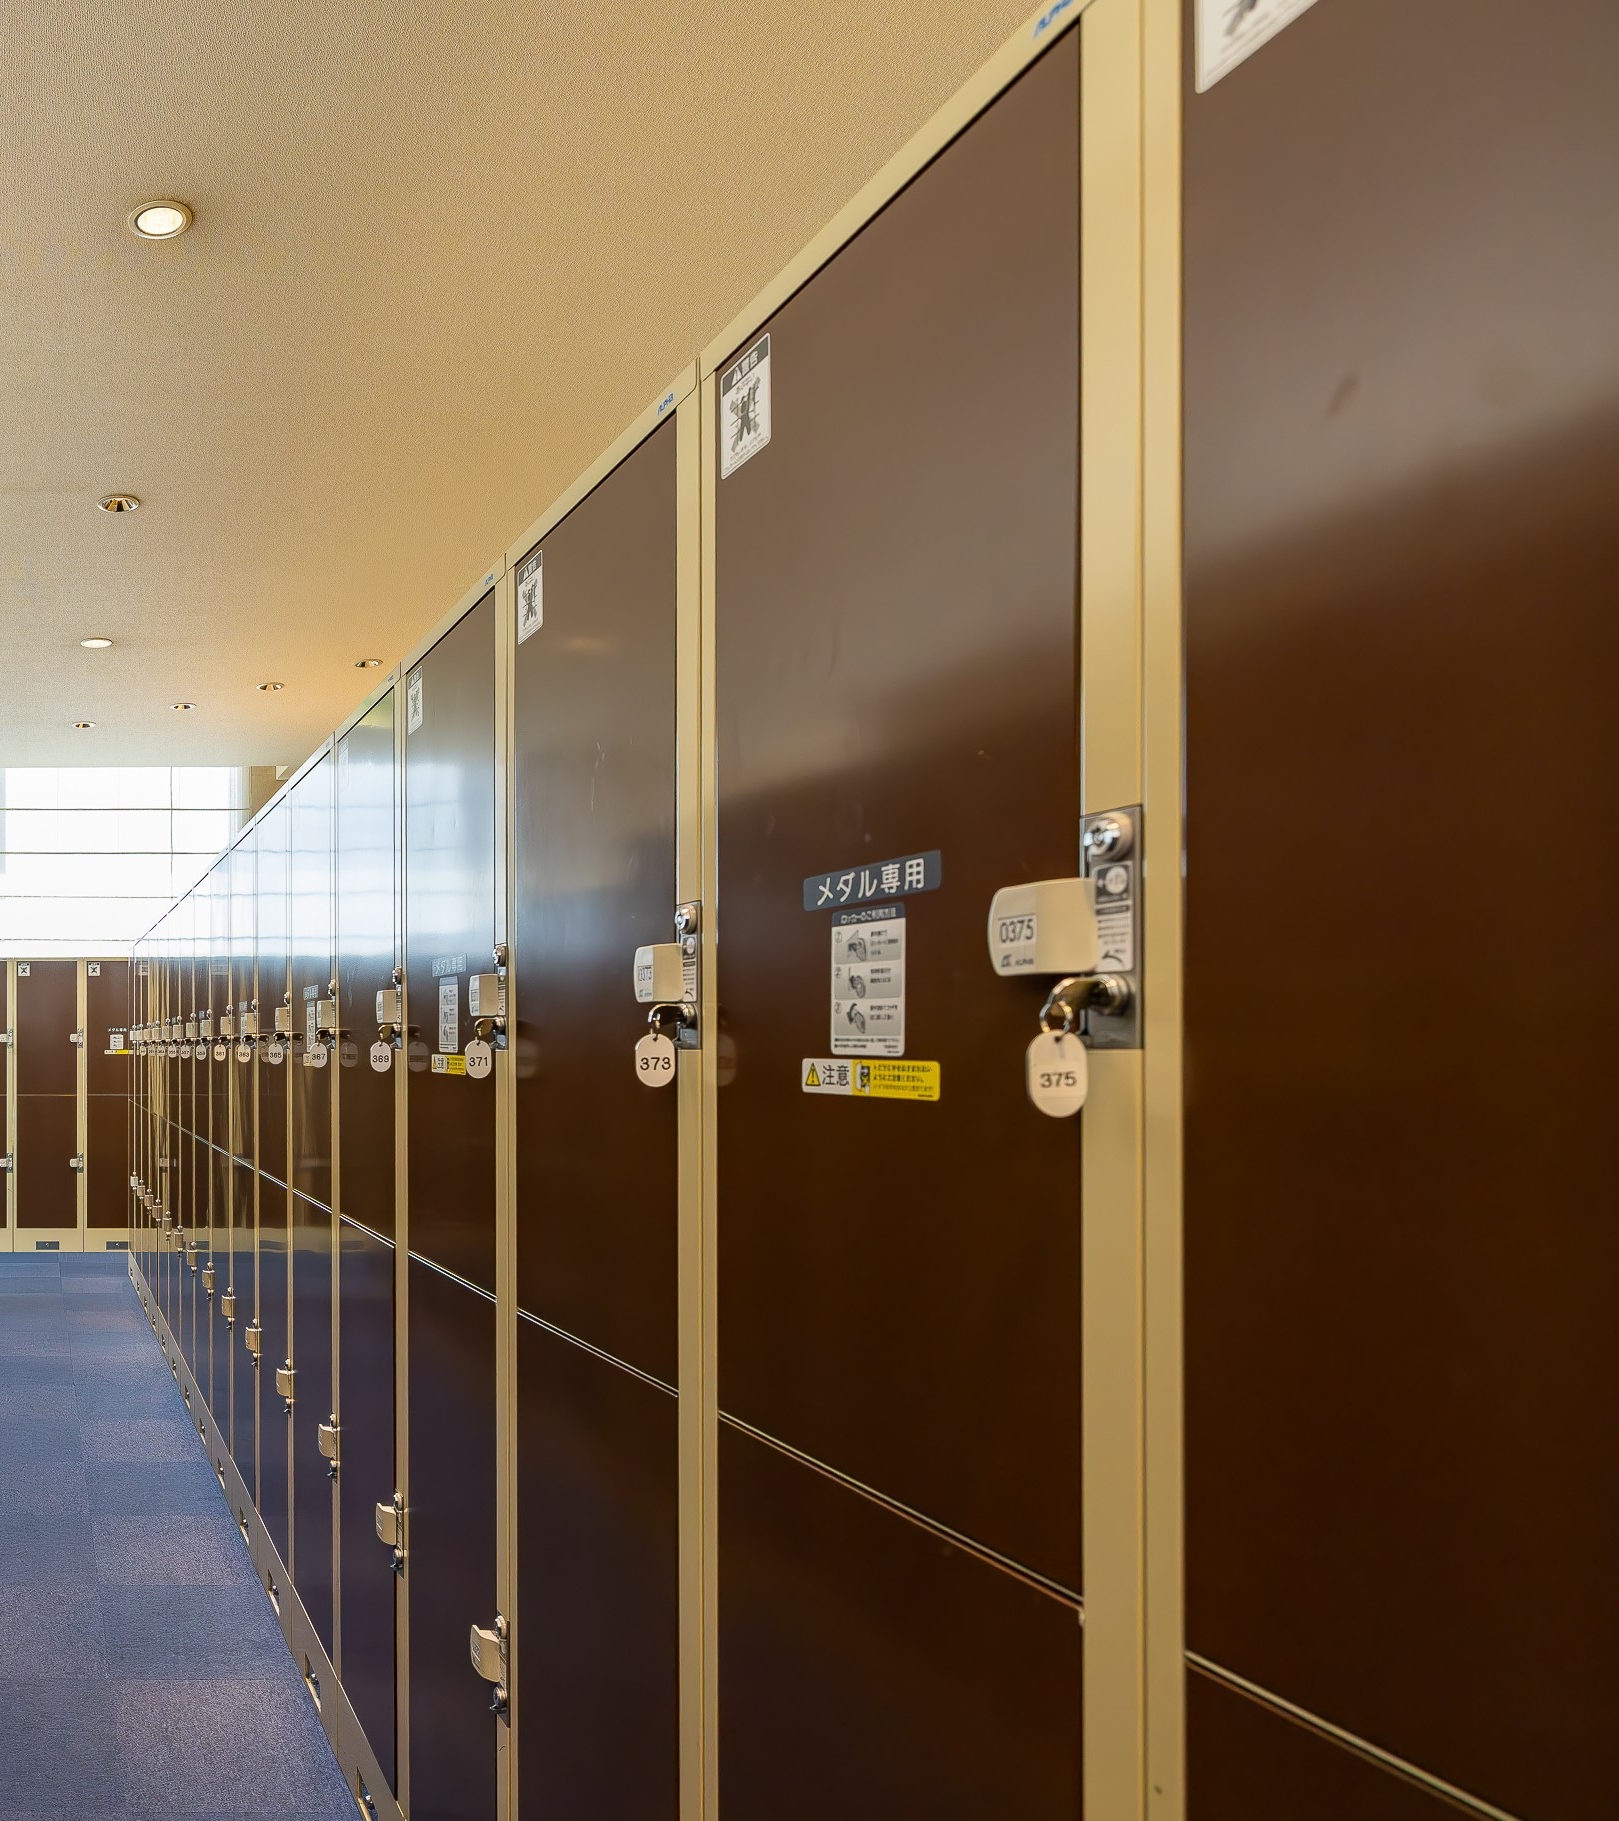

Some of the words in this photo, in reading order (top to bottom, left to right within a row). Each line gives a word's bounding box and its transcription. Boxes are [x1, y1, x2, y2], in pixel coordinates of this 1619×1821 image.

[816, 857, 925, 907] メダル専用
[1000, 918, 1034, 944] 0375
[270, 1052, 282, 1060] 365
[372, 1055, 390, 1063] 369
[469, 1056, 489, 1067] 371
[640, 1057, 671, 1071] 373
[822, 1064, 851, 1087] 注意
[1039, 1071, 1078, 1089] 375
